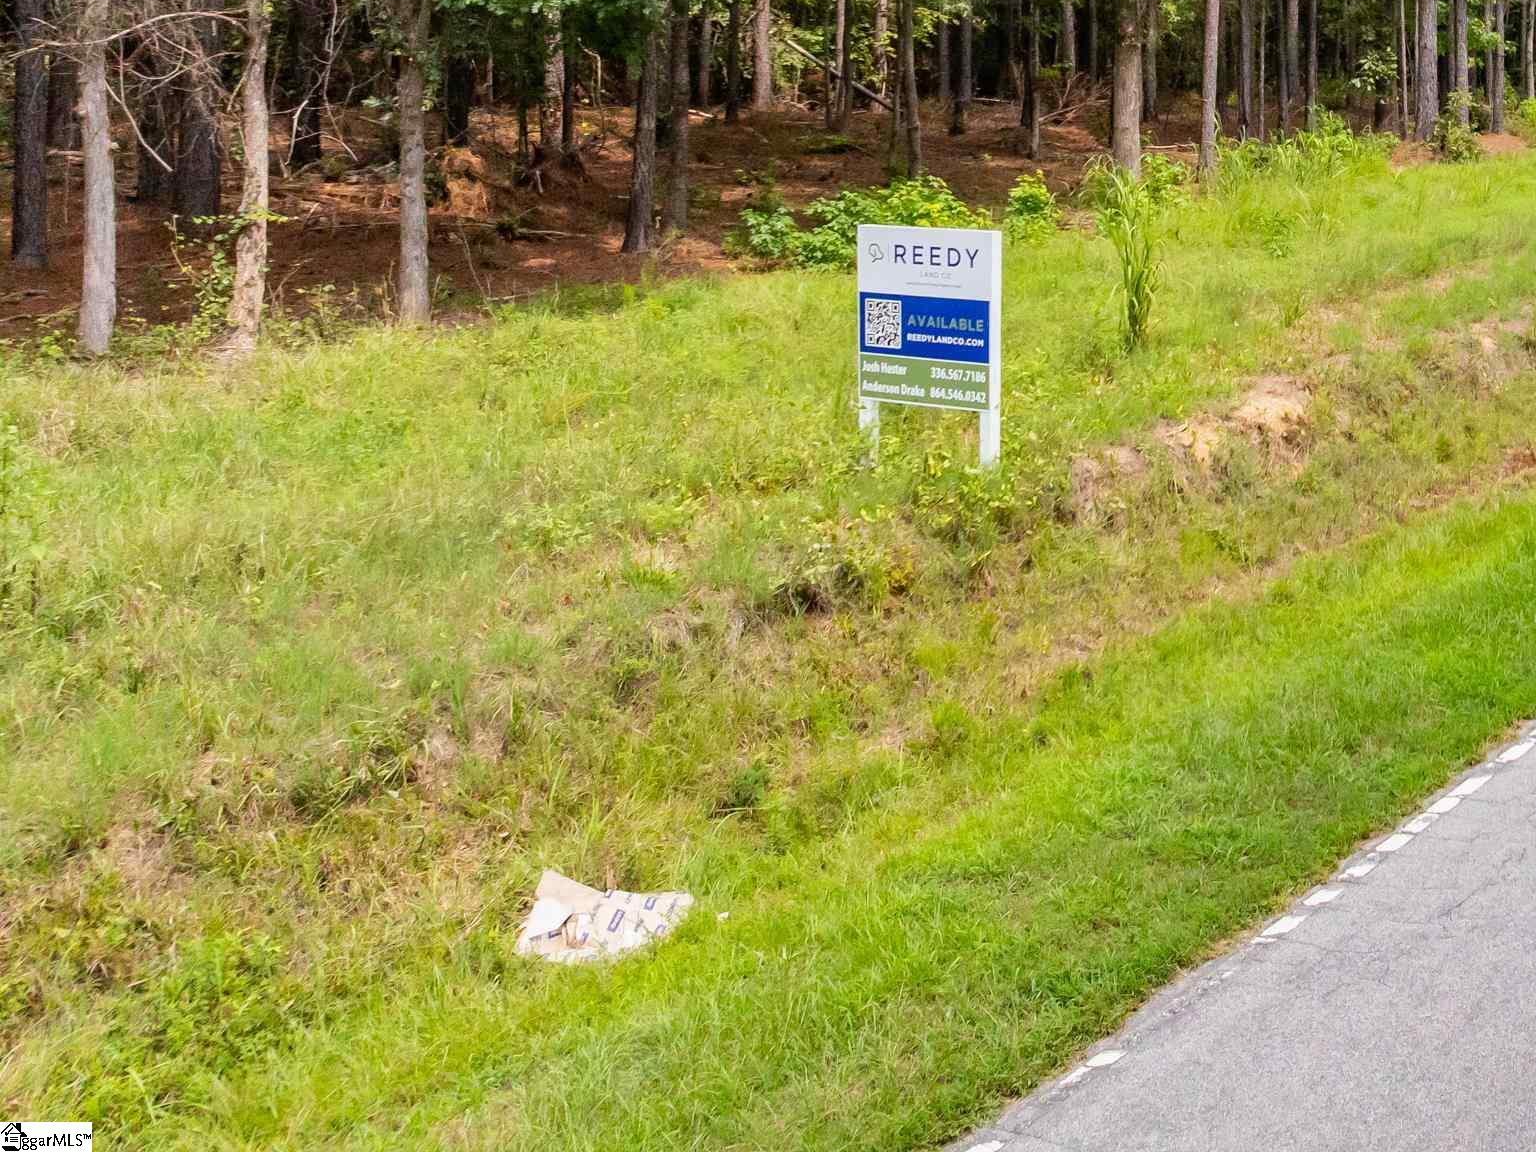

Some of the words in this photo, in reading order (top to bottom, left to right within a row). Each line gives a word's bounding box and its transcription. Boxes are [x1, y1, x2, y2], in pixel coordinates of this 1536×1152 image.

[893, 244, 979, 269] REEDY
[907, 314, 984, 332] AVAILABLE
[906, 332, 985, 348] REEDYLANDCO.COM
[862, 360, 881, 373] Josh
[862, 379, 900, 394] Anderson
[901, 383, 925, 397] Drake
